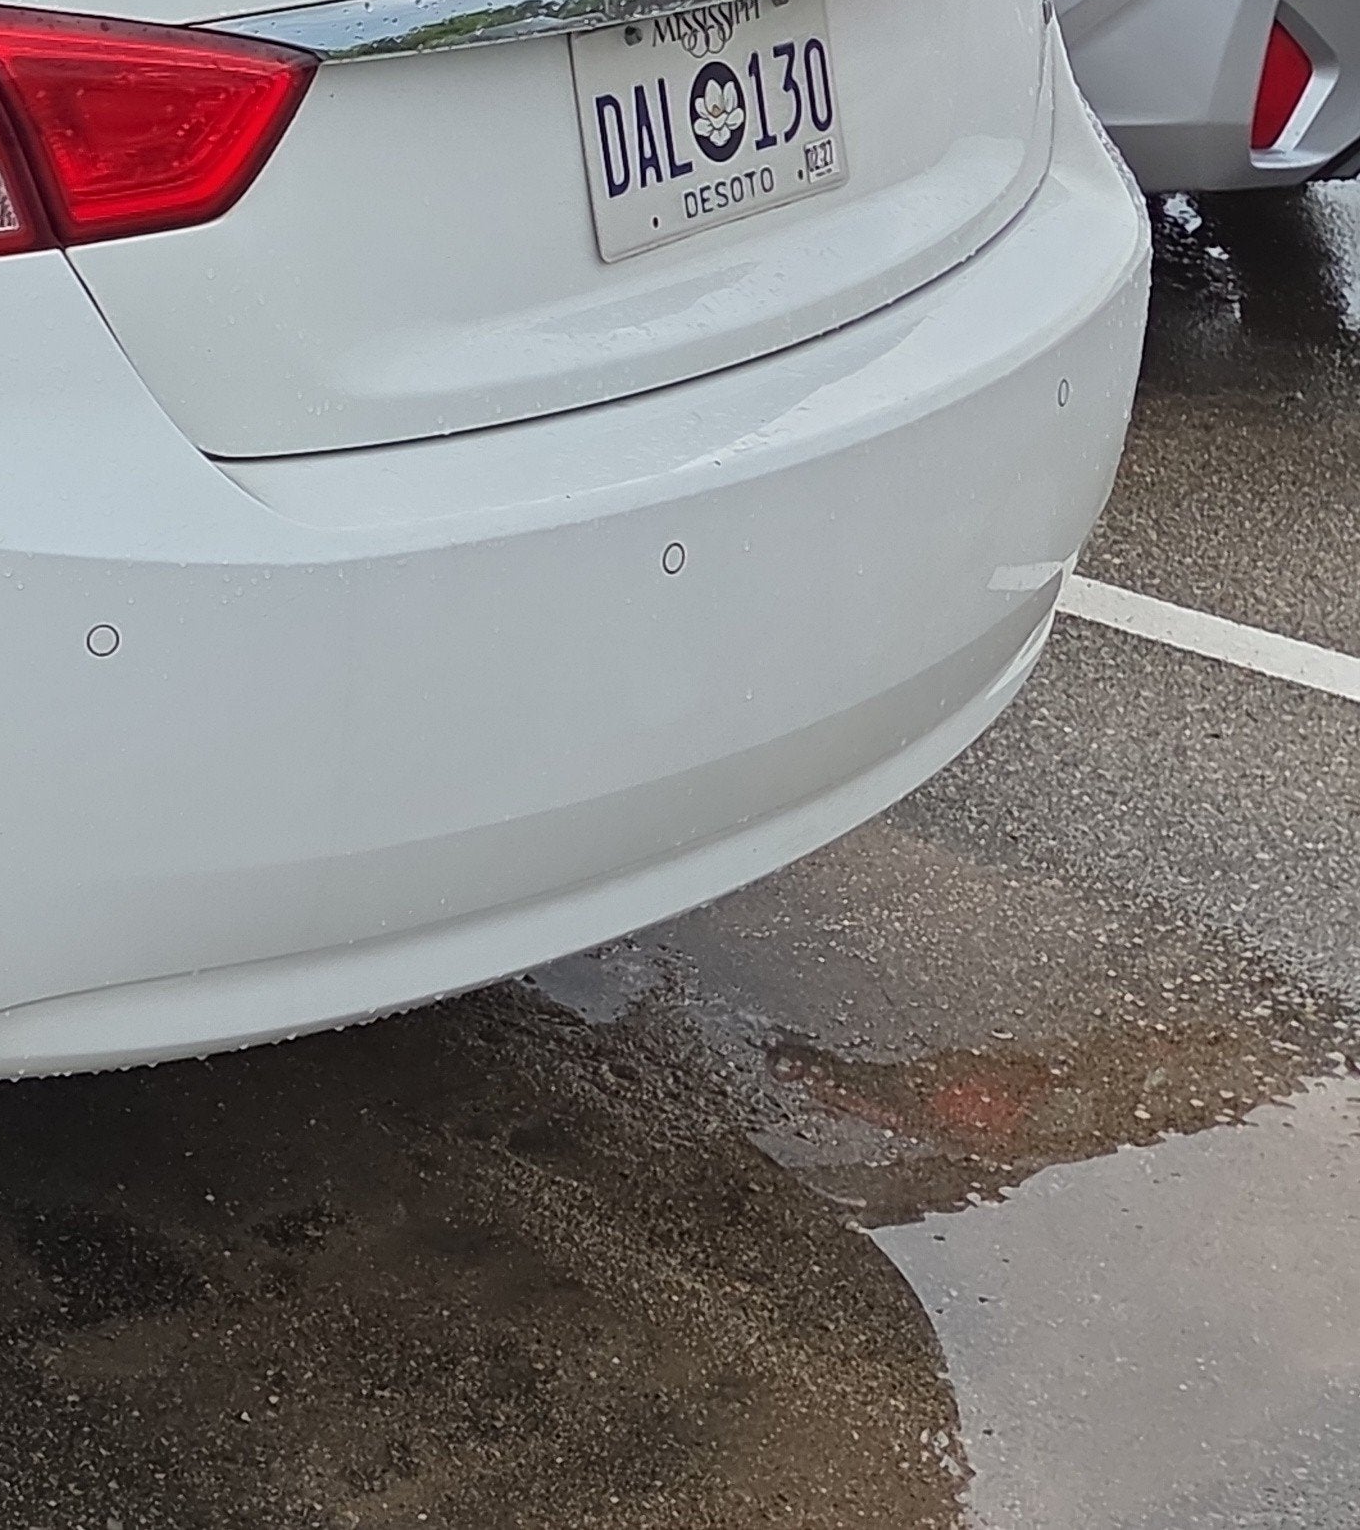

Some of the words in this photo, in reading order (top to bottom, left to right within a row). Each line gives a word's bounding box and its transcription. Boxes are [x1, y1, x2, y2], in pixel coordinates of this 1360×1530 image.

[595, 77, 694, 199] DAL
[748, 37, 834, 151] 130
[683, 166, 775, 219] DESOTO
